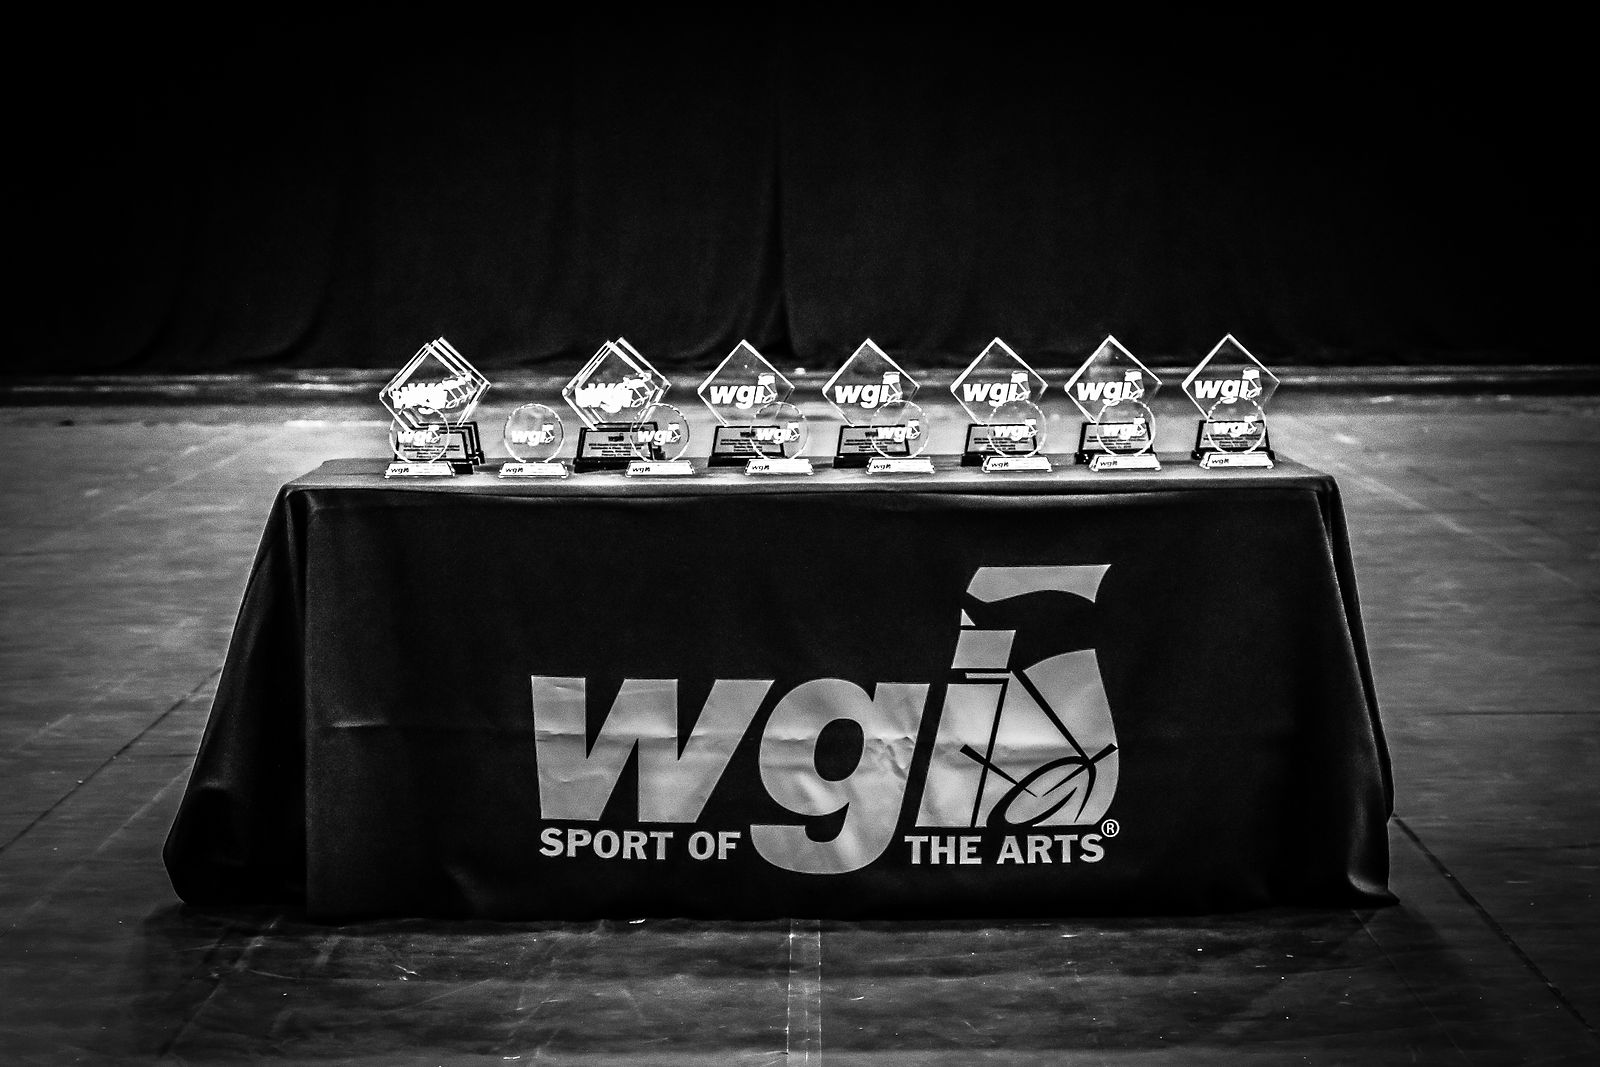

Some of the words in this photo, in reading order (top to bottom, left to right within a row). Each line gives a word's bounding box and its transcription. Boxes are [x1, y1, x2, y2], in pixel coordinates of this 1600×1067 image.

[531, 564, 1119, 875] wgi
[539, 827, 674, 860] SPORT
[687, 831, 741, 860] OF
[904, 835, 982, 864] THE
